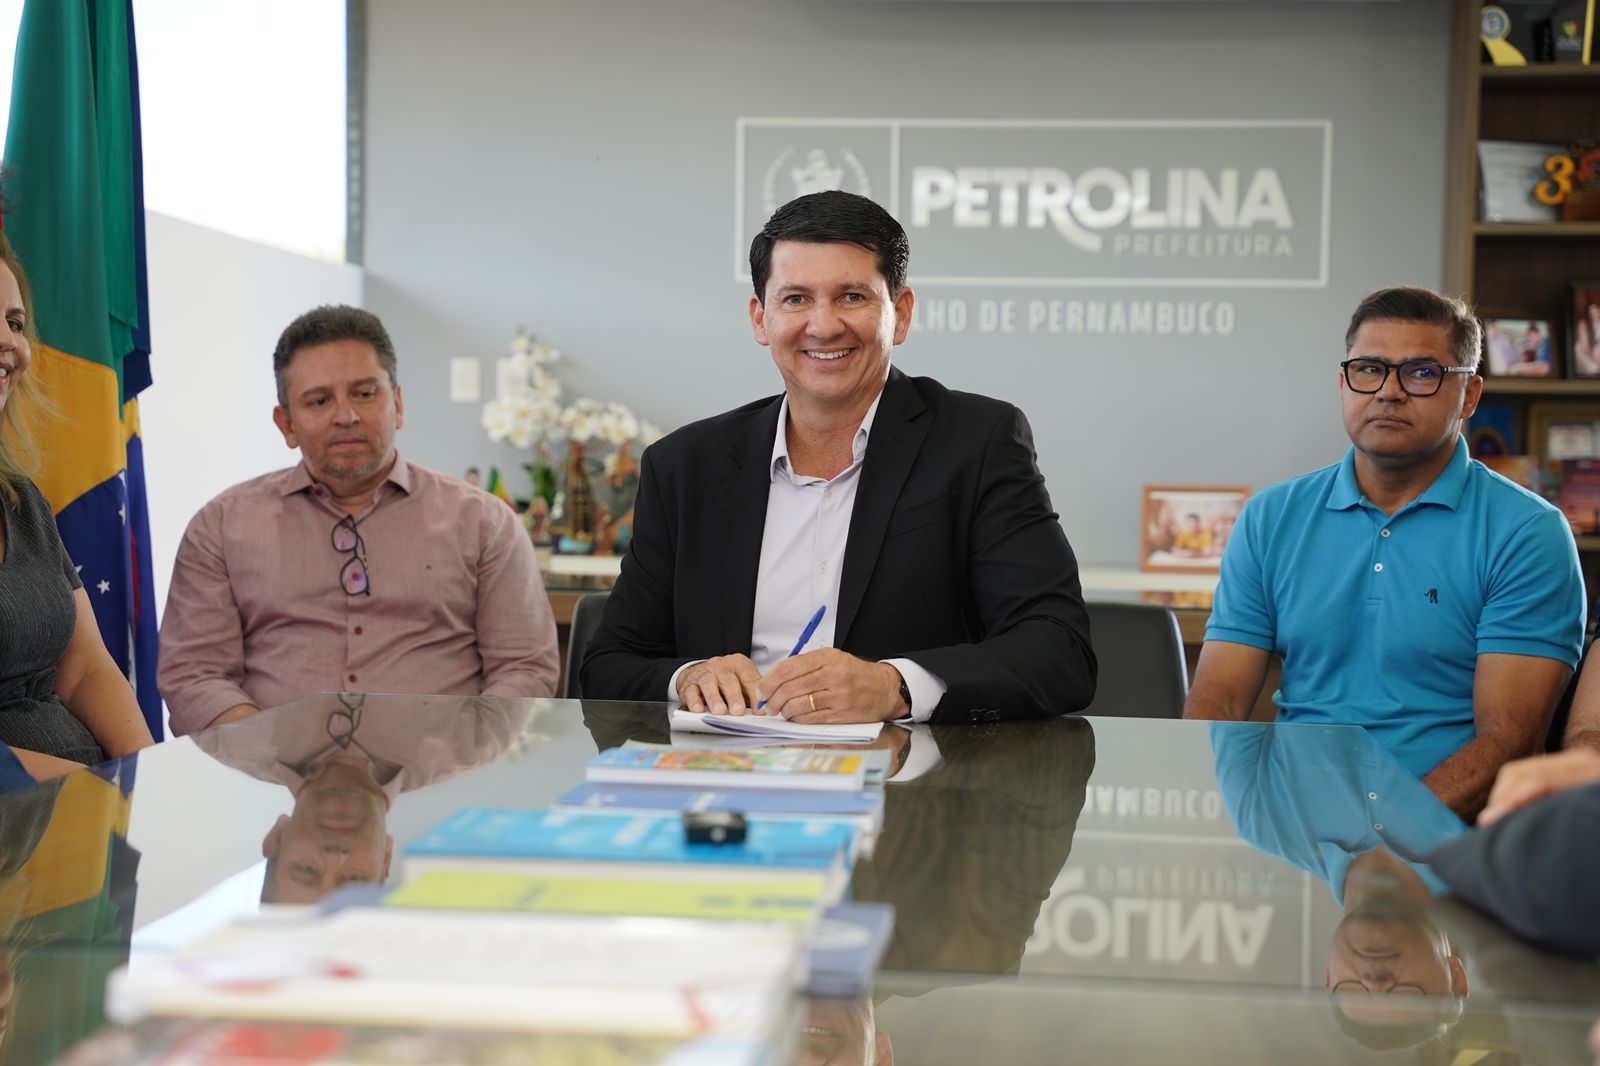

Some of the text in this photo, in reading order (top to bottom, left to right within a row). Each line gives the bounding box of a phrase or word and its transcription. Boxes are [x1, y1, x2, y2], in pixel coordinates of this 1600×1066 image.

[911, 166, 1294, 252] PETROLINA
[1113, 233, 1293, 257] PREFEITURA
[978, 300, 1017, 332] DE
[1028, 300, 1235, 335] PERNAMBUCO
